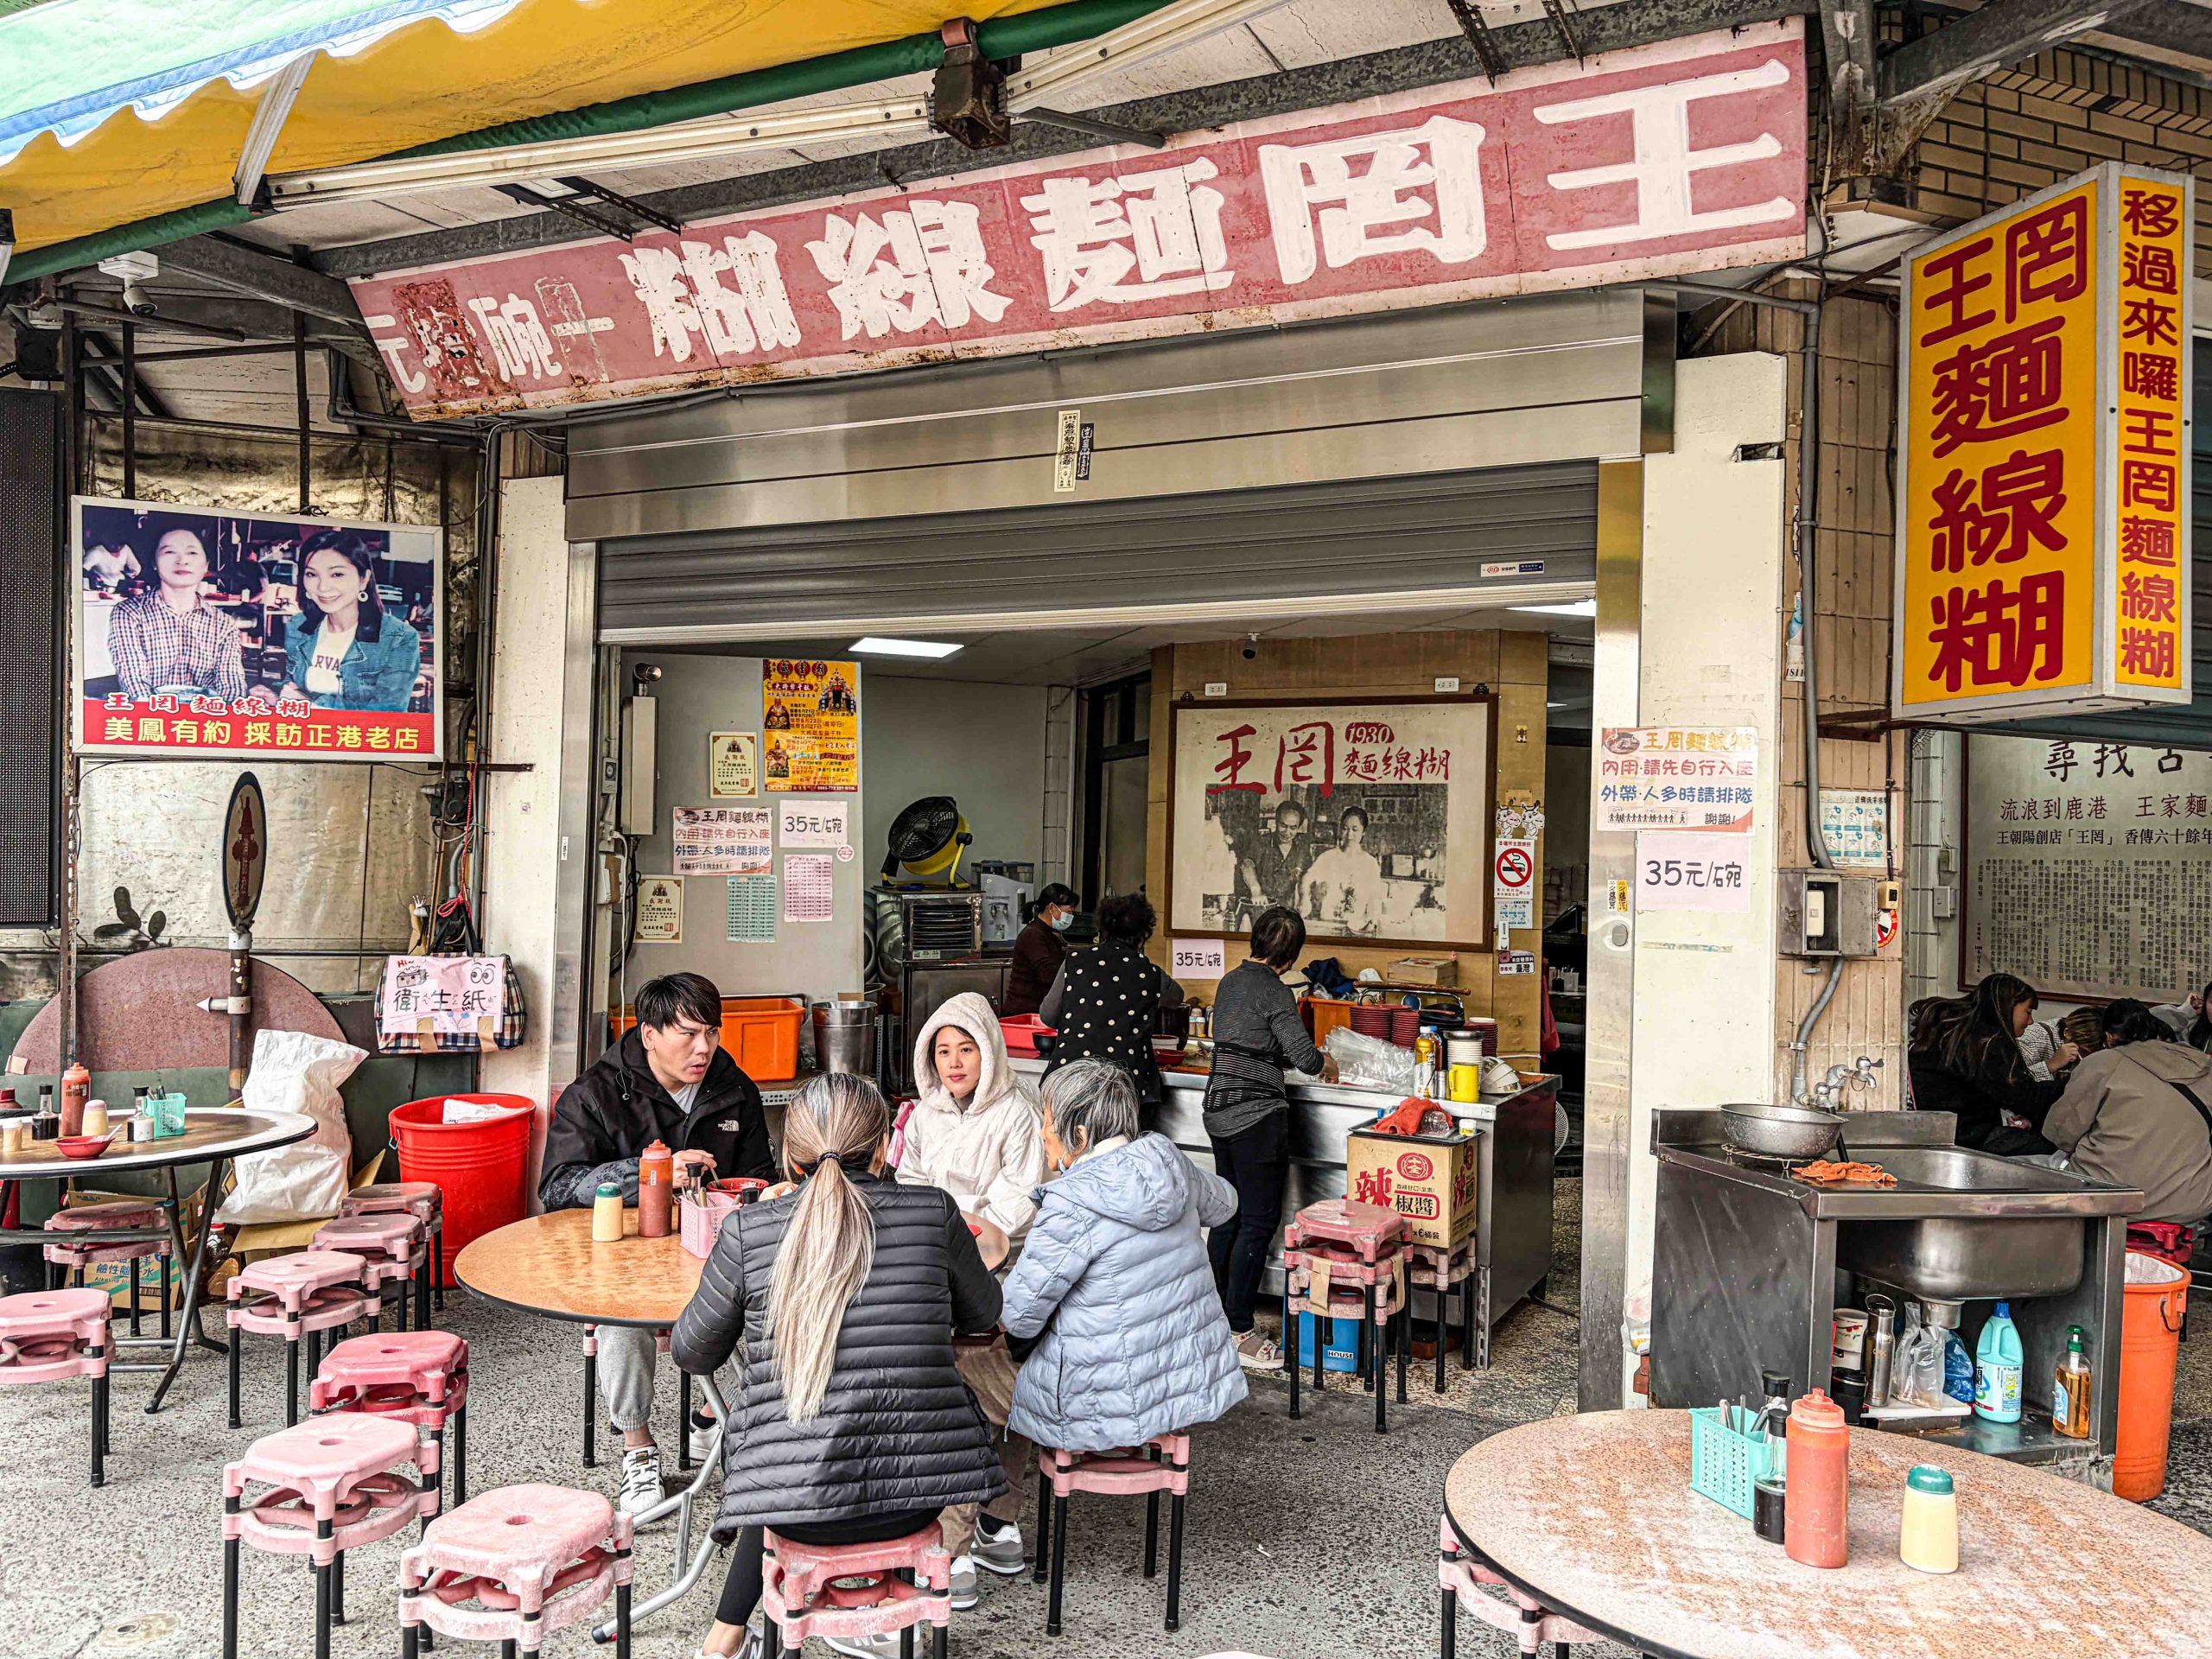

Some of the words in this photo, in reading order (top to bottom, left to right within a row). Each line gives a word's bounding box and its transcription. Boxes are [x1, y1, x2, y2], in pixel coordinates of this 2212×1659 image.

[2120, 188, 2179, 678] 移過來囉王罔麵線糊
[104, 691, 312, 719] 王罔麵線糊
[104, 716, 232, 746] 美鳳有約
[244, 721, 421, 750] 採訪正港老店
[1347, 725, 1392, 743] 1930
[1205, 721, 1334, 799] 王罔
[1343, 746, 1452, 782] 麵線糊
[2043, 740, 2212, 783] 尋找古
[1999, 795, 2108, 822] 流浪到鹿港
[2135, 791, 2212, 819] 王家麵
[784, 815, 843, 834] 35元/碗
[2125, 827, 2212, 845] 香傳六十餘年
[1644, 860, 1743, 888] 35元/碗
[1175, 951, 1221, 967] 35元/碗
[1395, 1194, 1433, 1216] 椒醬
[96, 1262, 154, 1277] 鹼性離水
[1328, 1351, 1355, 1359] HOUSE
